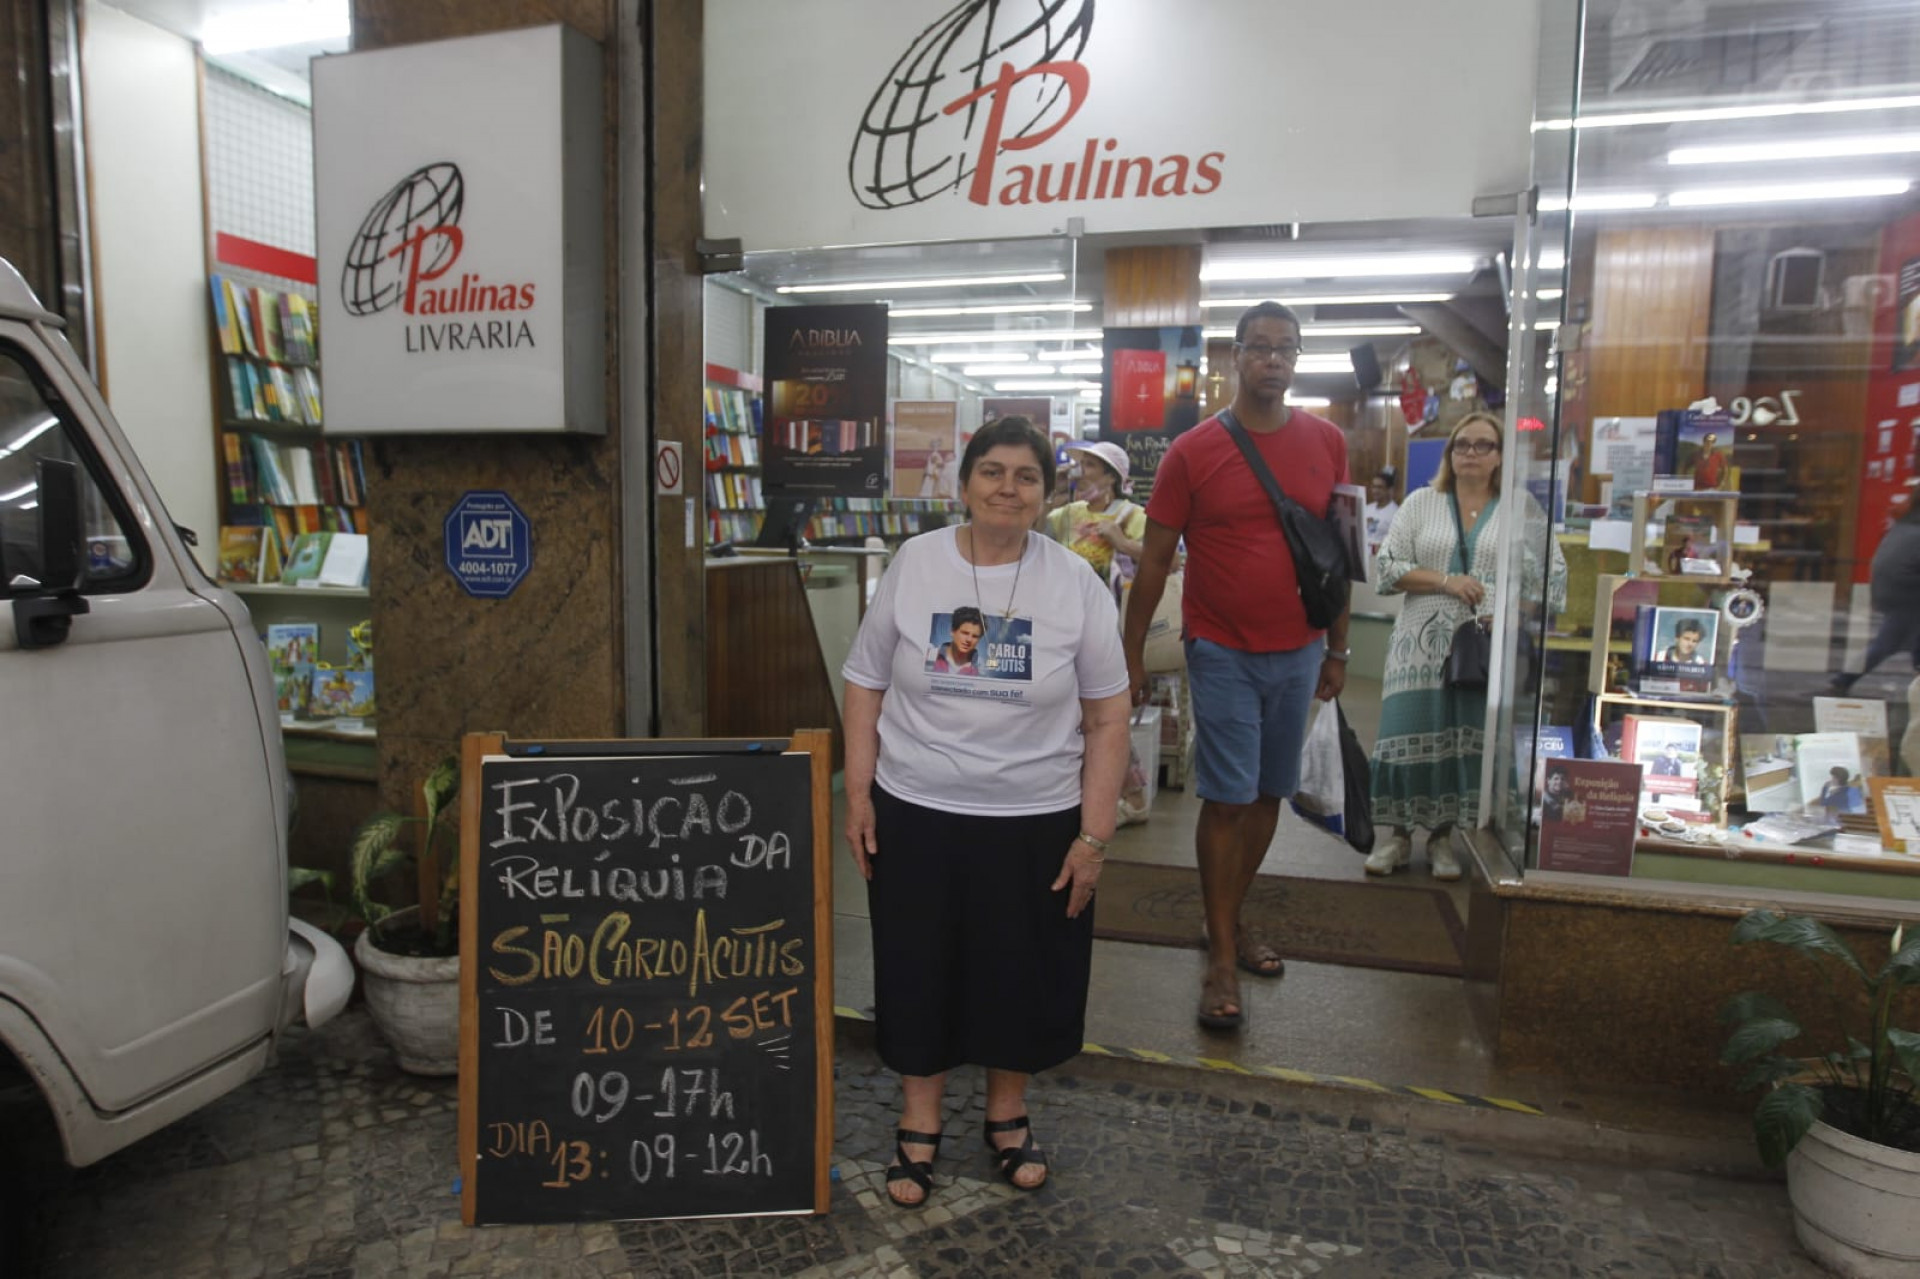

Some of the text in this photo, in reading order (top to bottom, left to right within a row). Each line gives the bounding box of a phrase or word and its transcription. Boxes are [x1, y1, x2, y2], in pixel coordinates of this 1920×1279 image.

[942, 60, 1226, 207] Paulinas
[388, 224, 536, 315] Paulinas
[405, 319, 536, 353] LIVRARIA
[463, 518, 511, 549] ADT
[459, 561, 518, 575] 4004-1077
[987, 659, 1026, 673] CUTIS
[988, 643, 1026, 659] CARLO
[730, 831, 791, 870] DA
[489, 850, 728, 902] RELÍQUIA
[488, 907, 805, 997] SÃO CARLO ACUTIS
[493, 1007, 557, 1047] DE
[720, 986, 799, 1038] SET
[488, 1119, 551, 1158] DIA
